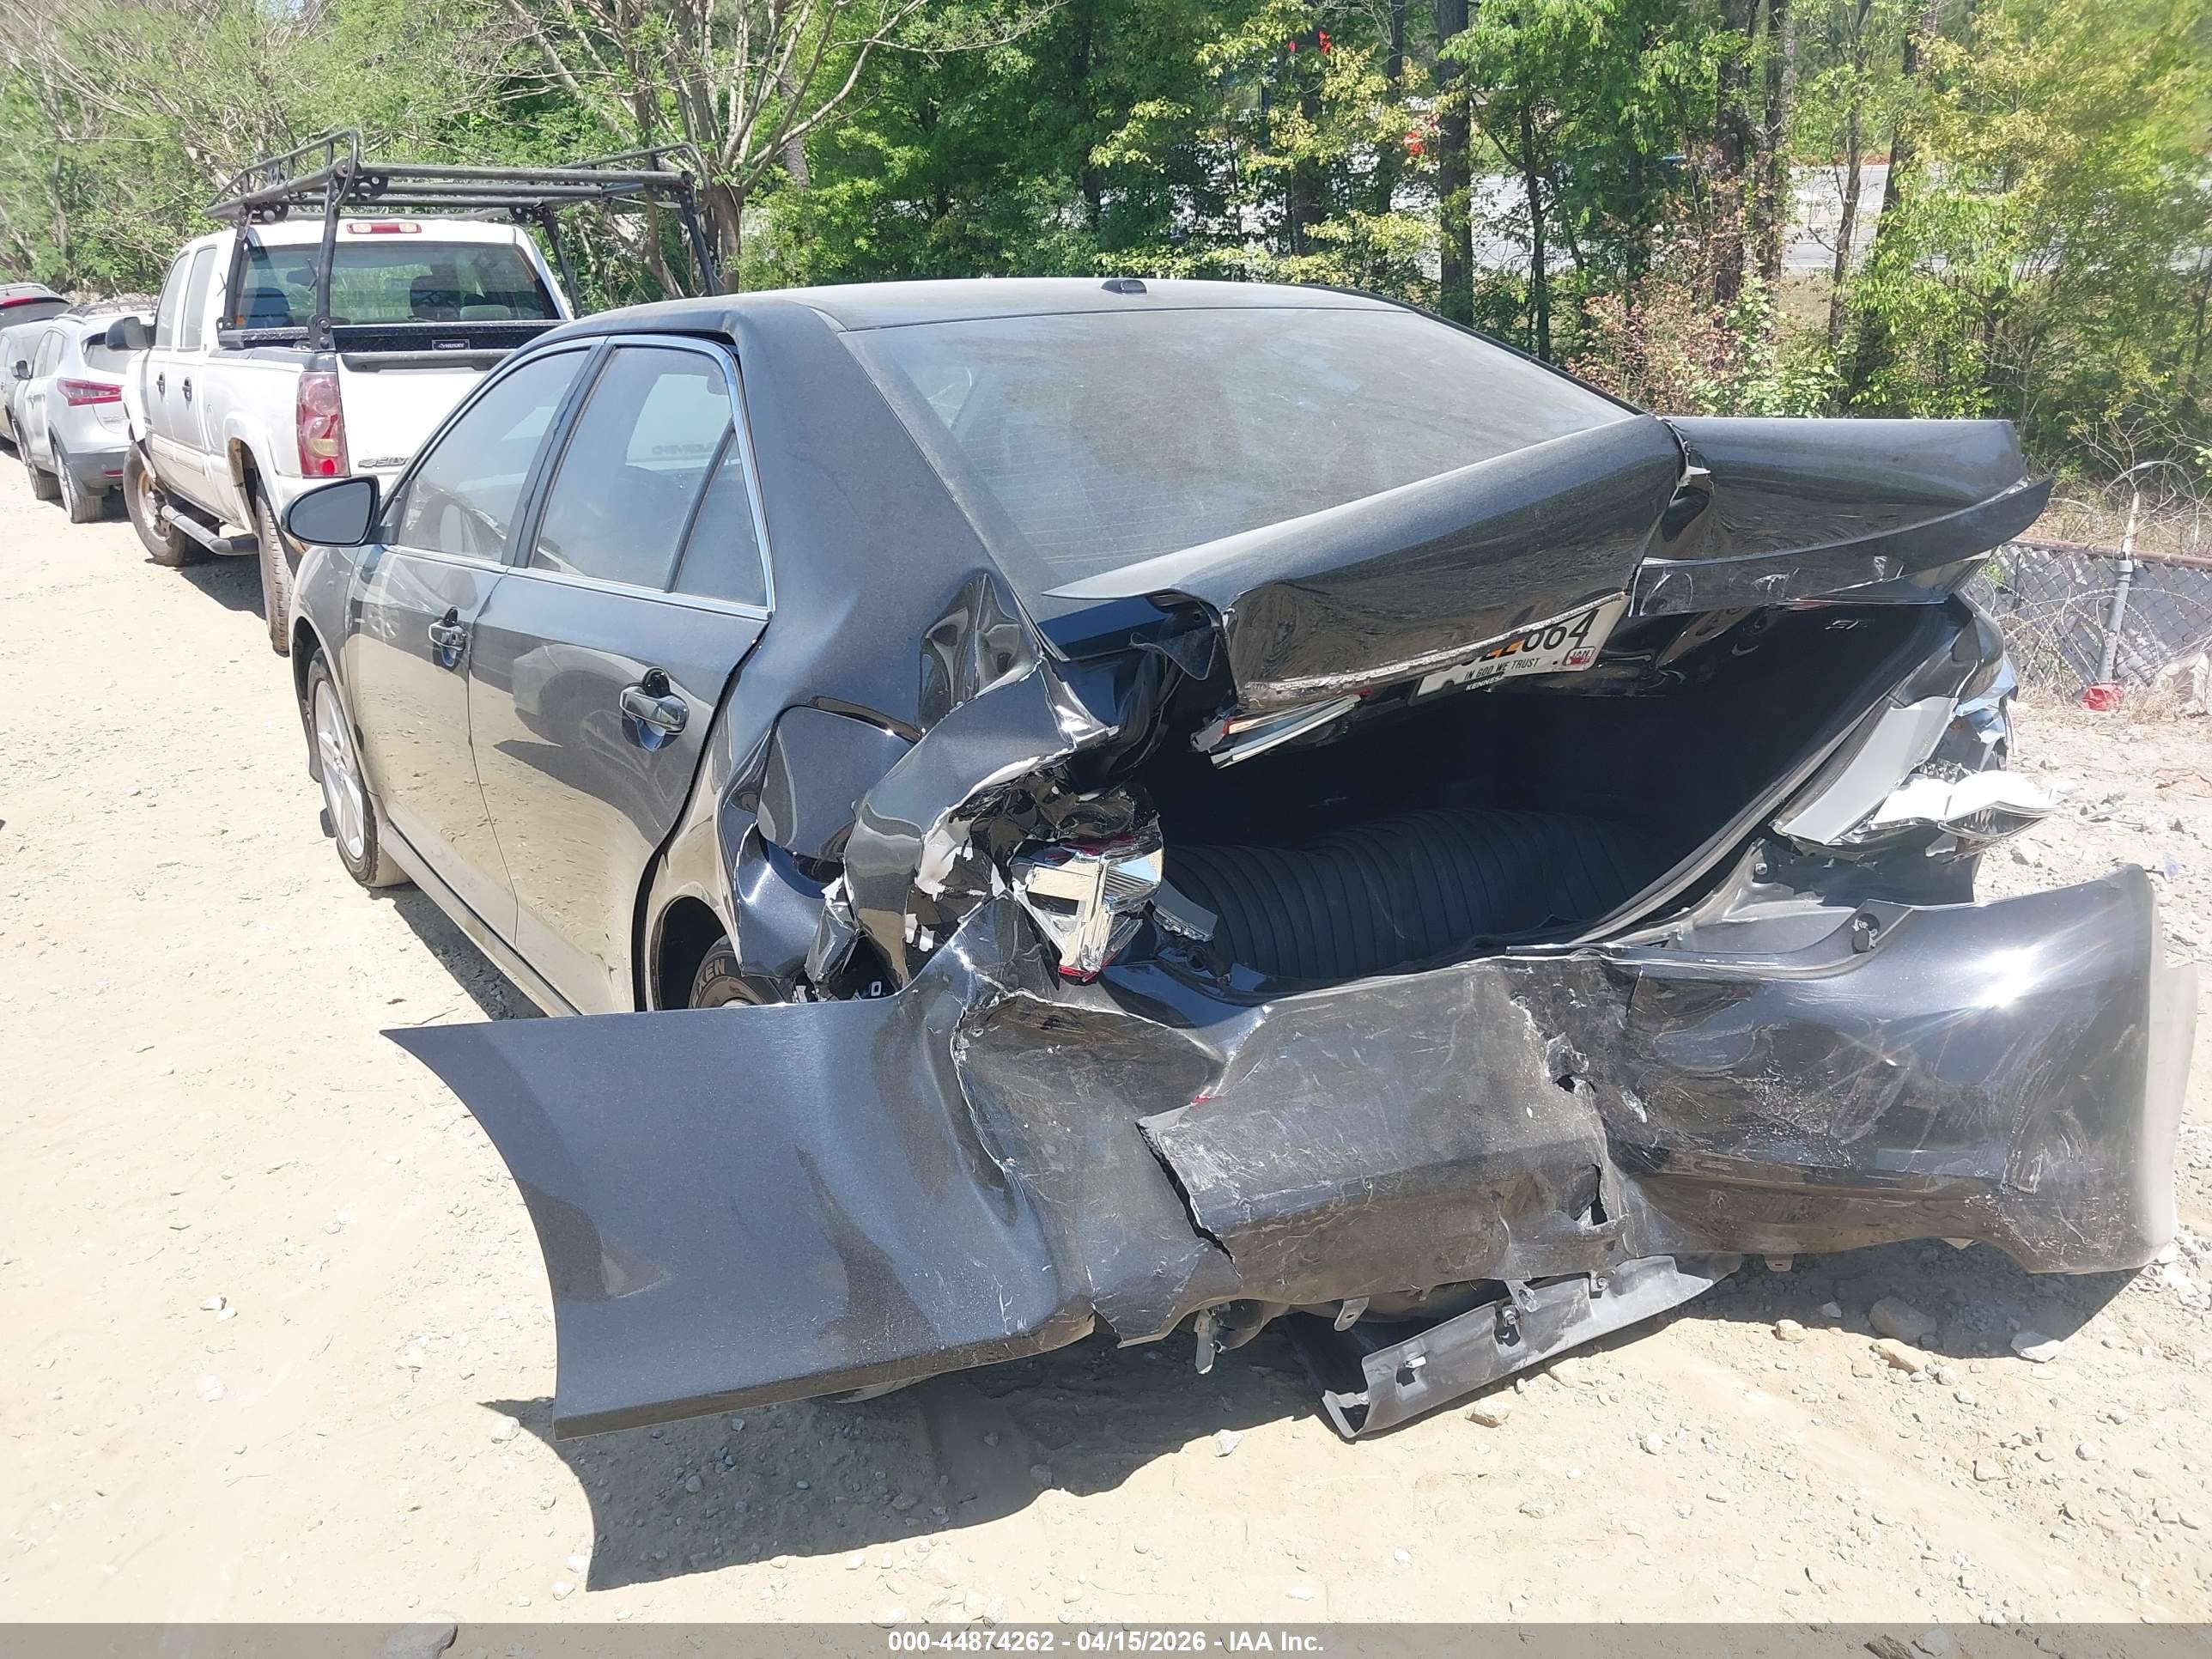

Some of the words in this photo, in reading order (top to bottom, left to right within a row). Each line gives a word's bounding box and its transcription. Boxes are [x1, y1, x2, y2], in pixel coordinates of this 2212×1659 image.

[376, 456, 409, 467] SILV
[1463, 670, 1475, 681] IN
[1476, 665, 1494, 678] GOD
[1496, 661, 1510, 672] WE
[1511, 658, 1540, 670] TRUST
